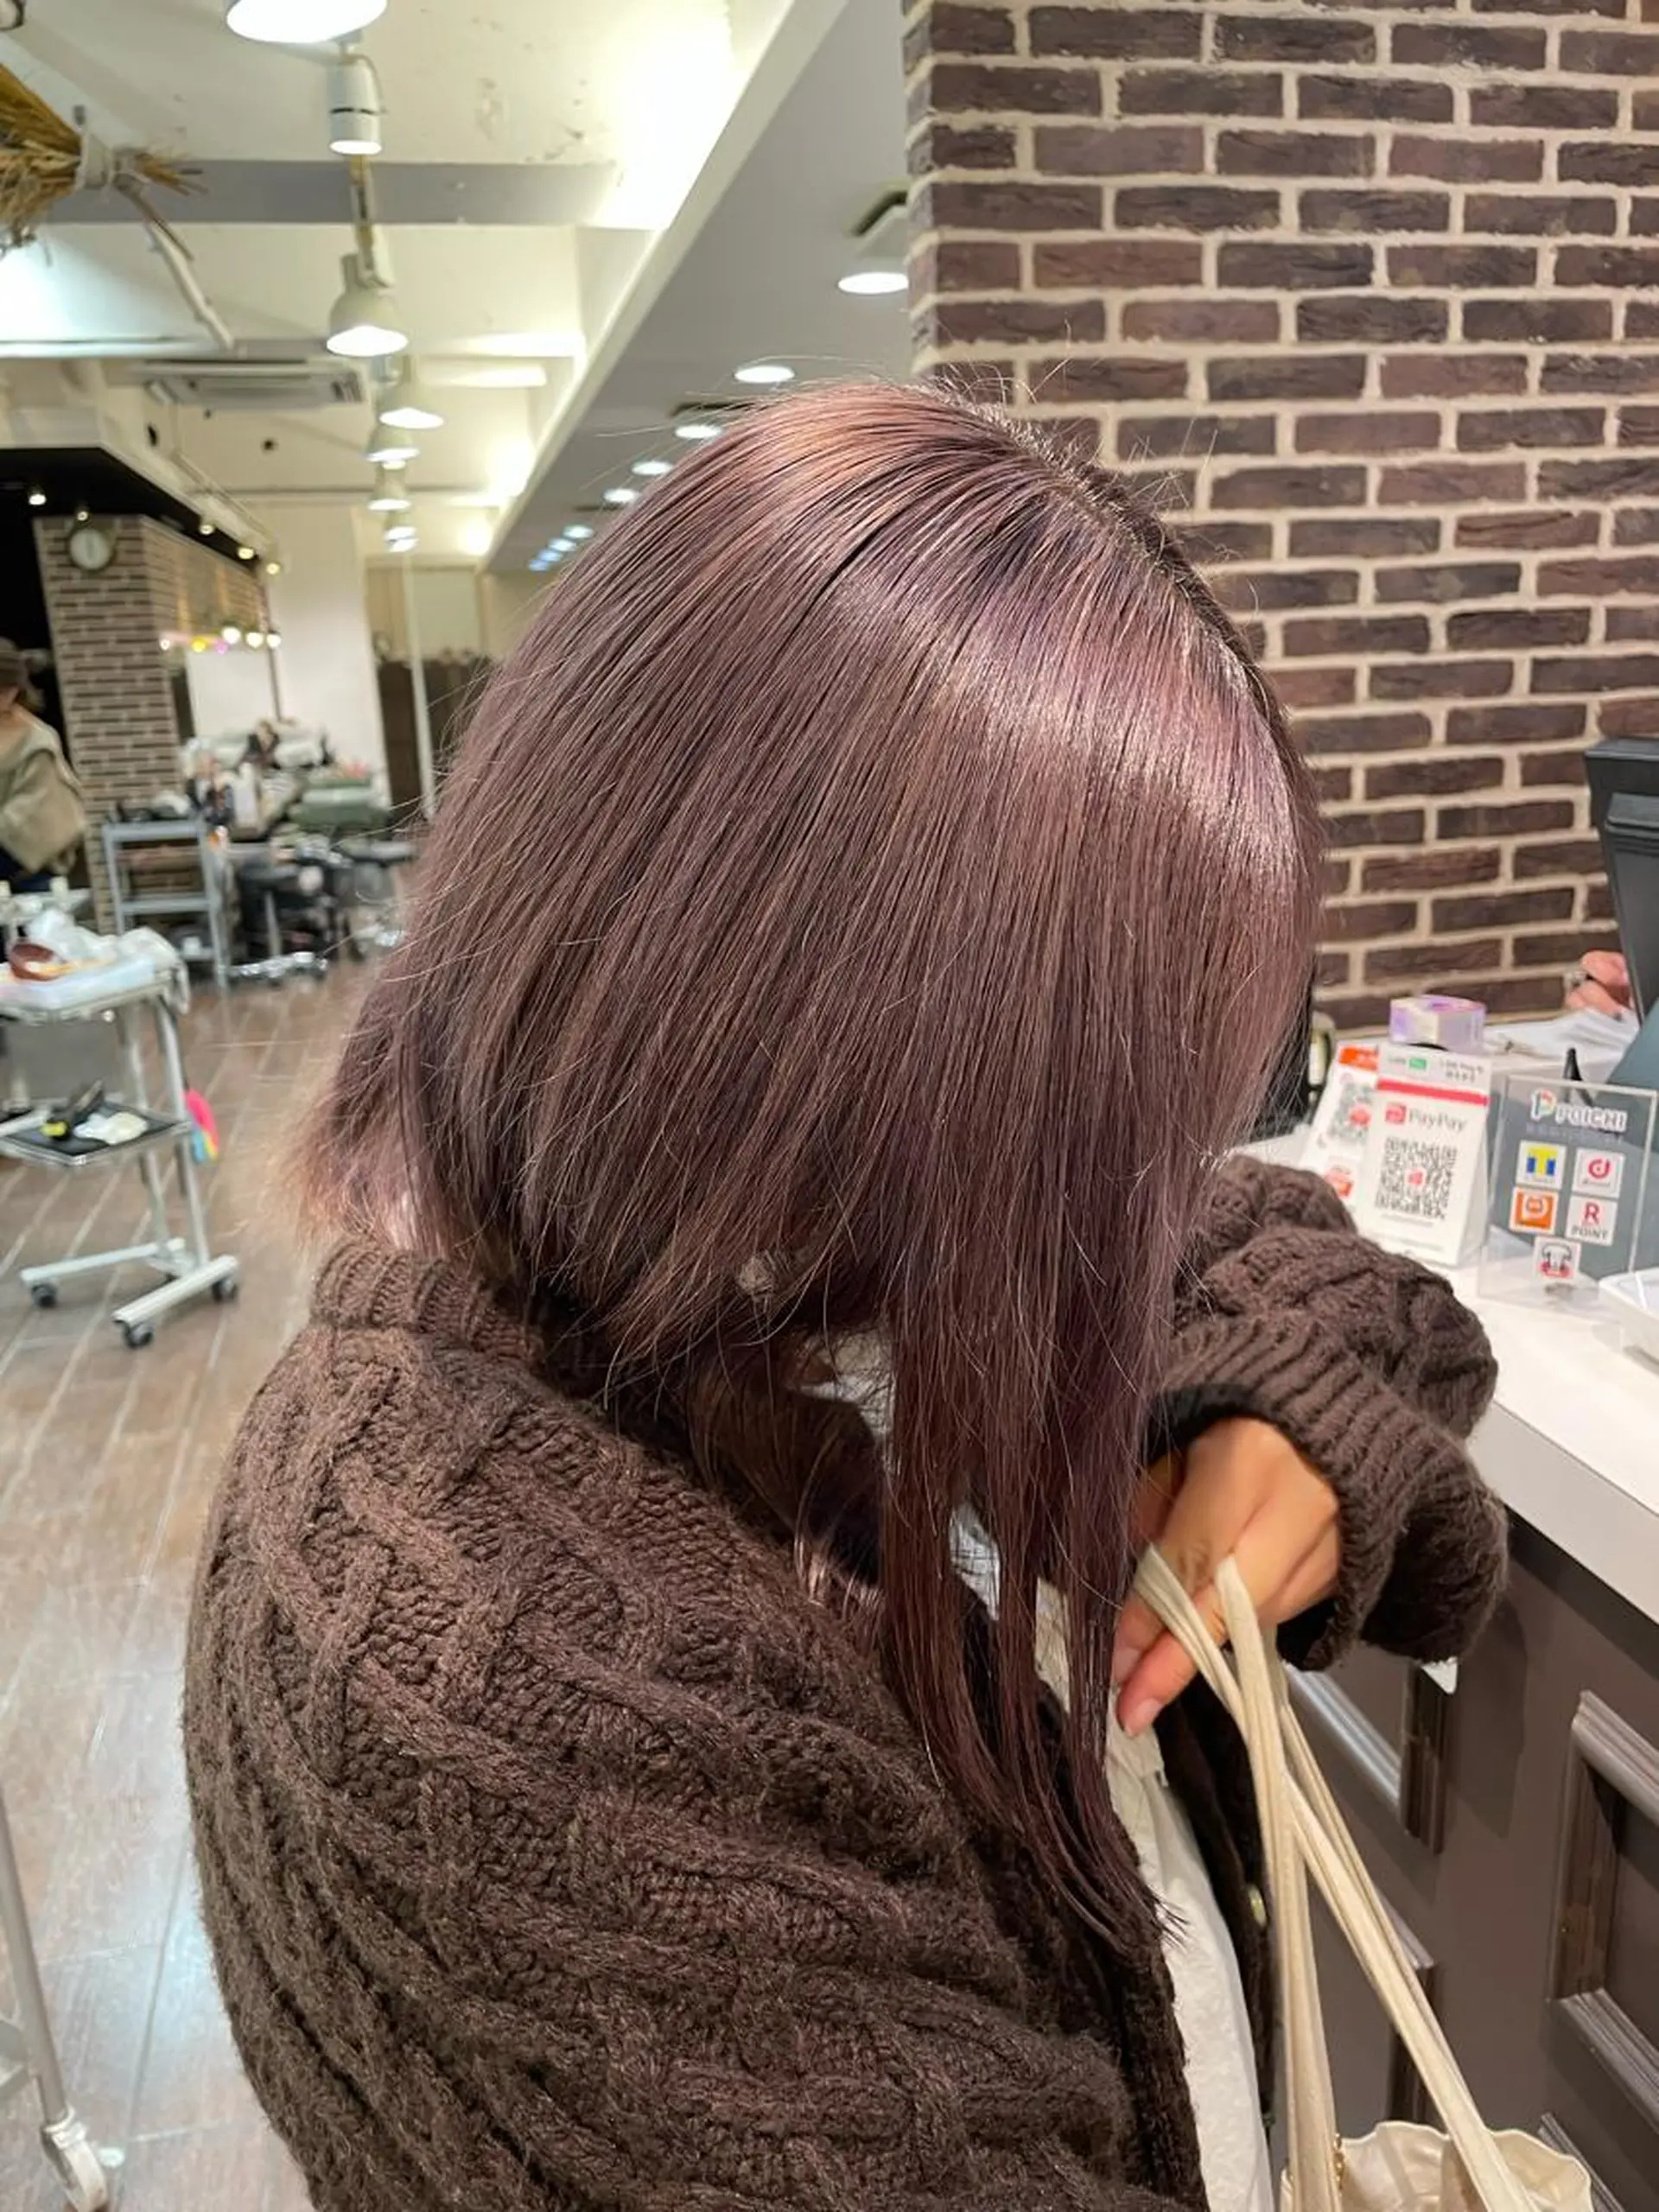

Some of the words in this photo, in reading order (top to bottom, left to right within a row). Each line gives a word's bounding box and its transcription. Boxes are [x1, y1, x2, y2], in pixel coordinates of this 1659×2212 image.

[1408, 1109, 1468, 1133] PayPay
[1583, 1201, 1601, 1224] R
[1570, 1223, 1610, 1241] POINT
